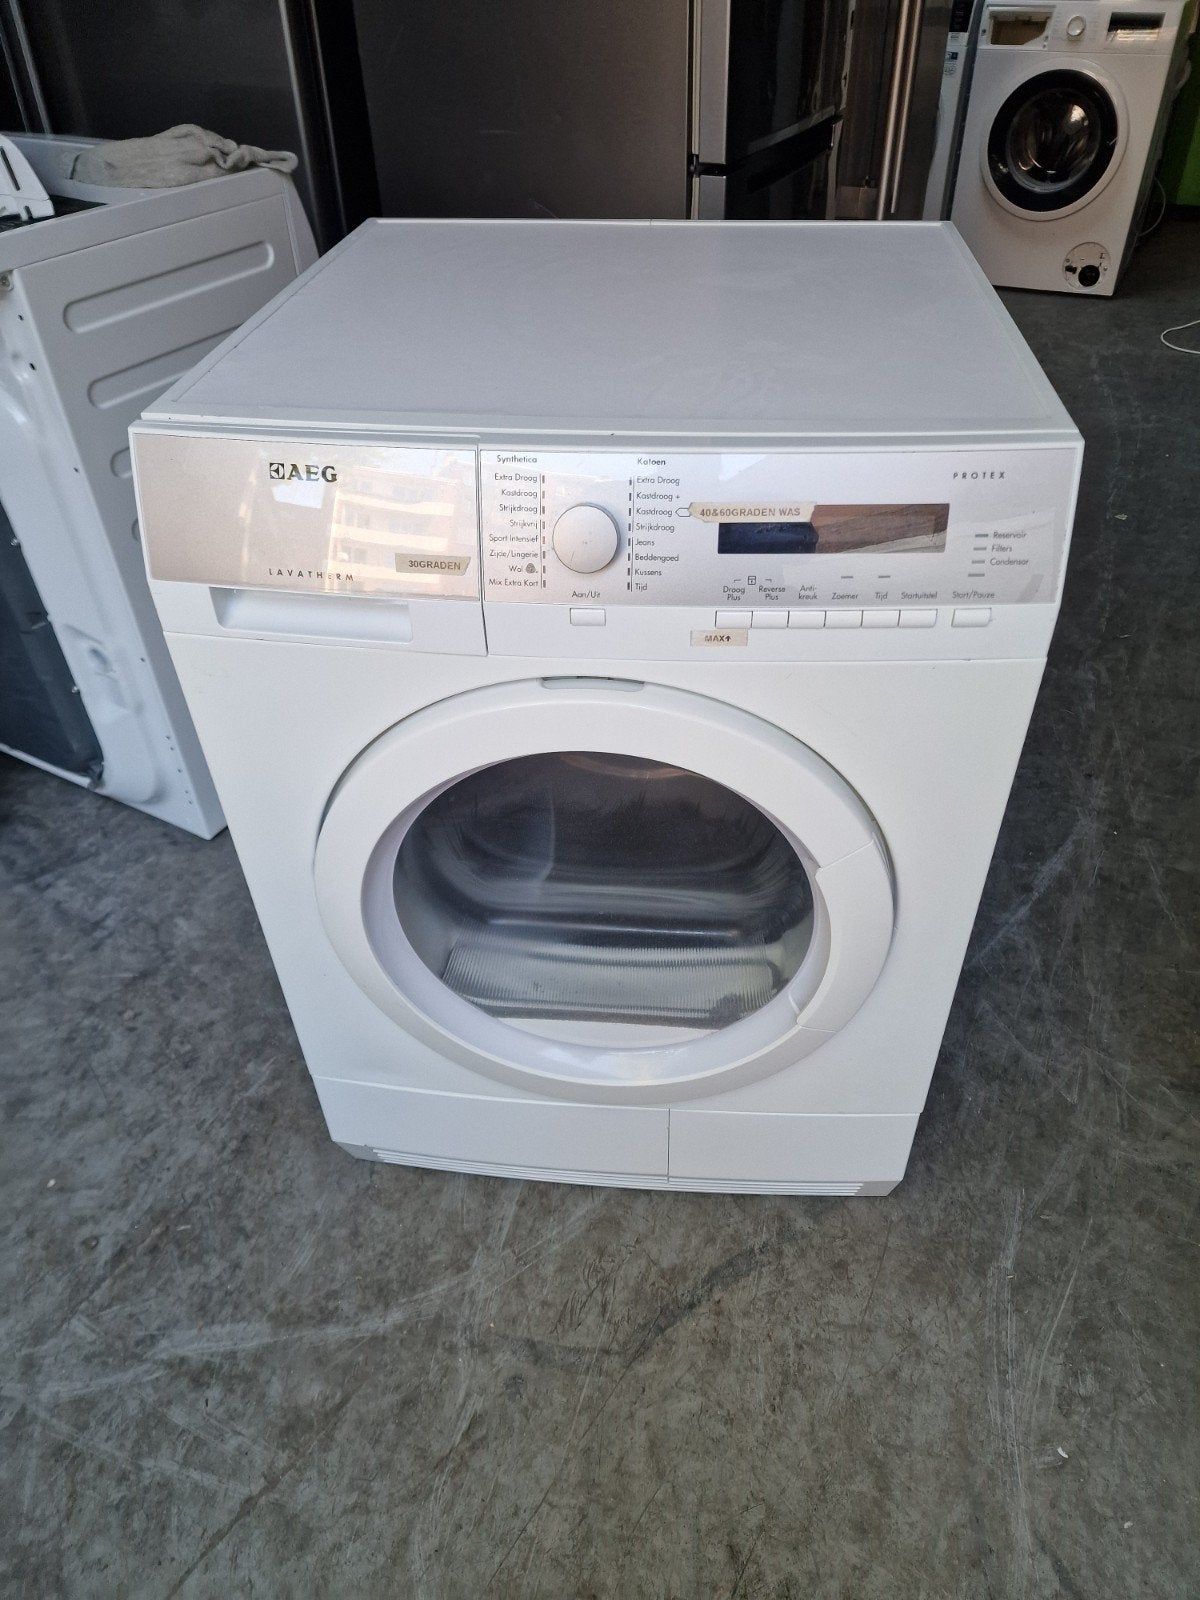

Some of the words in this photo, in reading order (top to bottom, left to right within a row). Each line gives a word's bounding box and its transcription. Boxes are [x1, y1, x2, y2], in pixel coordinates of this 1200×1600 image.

[496, 454, 538, 464] Synthetica
[637, 457, 667, 466] Katoen
[286, 463, 338, 483] AEG
[494, 472, 513, 481] Extra
[515, 473, 538, 484] Droog
[953, 471, 1006, 480] PROTEX
[637, 475, 656, 484] Extra
[657, 476, 681, 487] Droog
[501, 488, 538, 499] Kastdroog
[636, 491, 673, 502] Kastdroog
[499, 503, 538, 514] Strijkdroog
[636, 507, 673, 518] Kastdroog
[699, 507, 775, 518] 40&60GRADEN
[778, 506, 801, 517] WAS
[509, 519, 538, 530] Strijkvrij
[635, 522, 676, 534] Strijkdroog
[489, 533, 508, 543] Sport
[509, 534, 539, 543] Intensief
[993, 530, 1027, 540] Reservoir
[634, 538, 655, 547] Jeans
[991, 544, 1013, 553] Filters
[635, 553, 680, 564] Beddengoed
[989, 557, 1030, 566] Condensor
[408, 559, 461, 571] 30GRADEN
[268, 567, 354, 582] LAVATHERM
[635, 568, 662, 577] Kussens
[488, 578, 503, 586] Mix
[504, 578, 522, 587] Extra
[523, 579, 539, 587] Kort
[635, 582, 648, 592] Tijd
[723, 585, 746, 595] Droog
[758, 585, 786, 593] Reverse
[727, 593, 741, 601] Plus
[765, 593, 779, 601] Plus
[798, 592, 818, 601] kreuk
[831, 592, 859, 600] Zoemer
[875, 591, 889, 602] Tijd
[901, 591, 938, 600] Startuitstel
[952, 589, 996, 600] Start/Pauze
[704, 634, 725, 643] MAX
